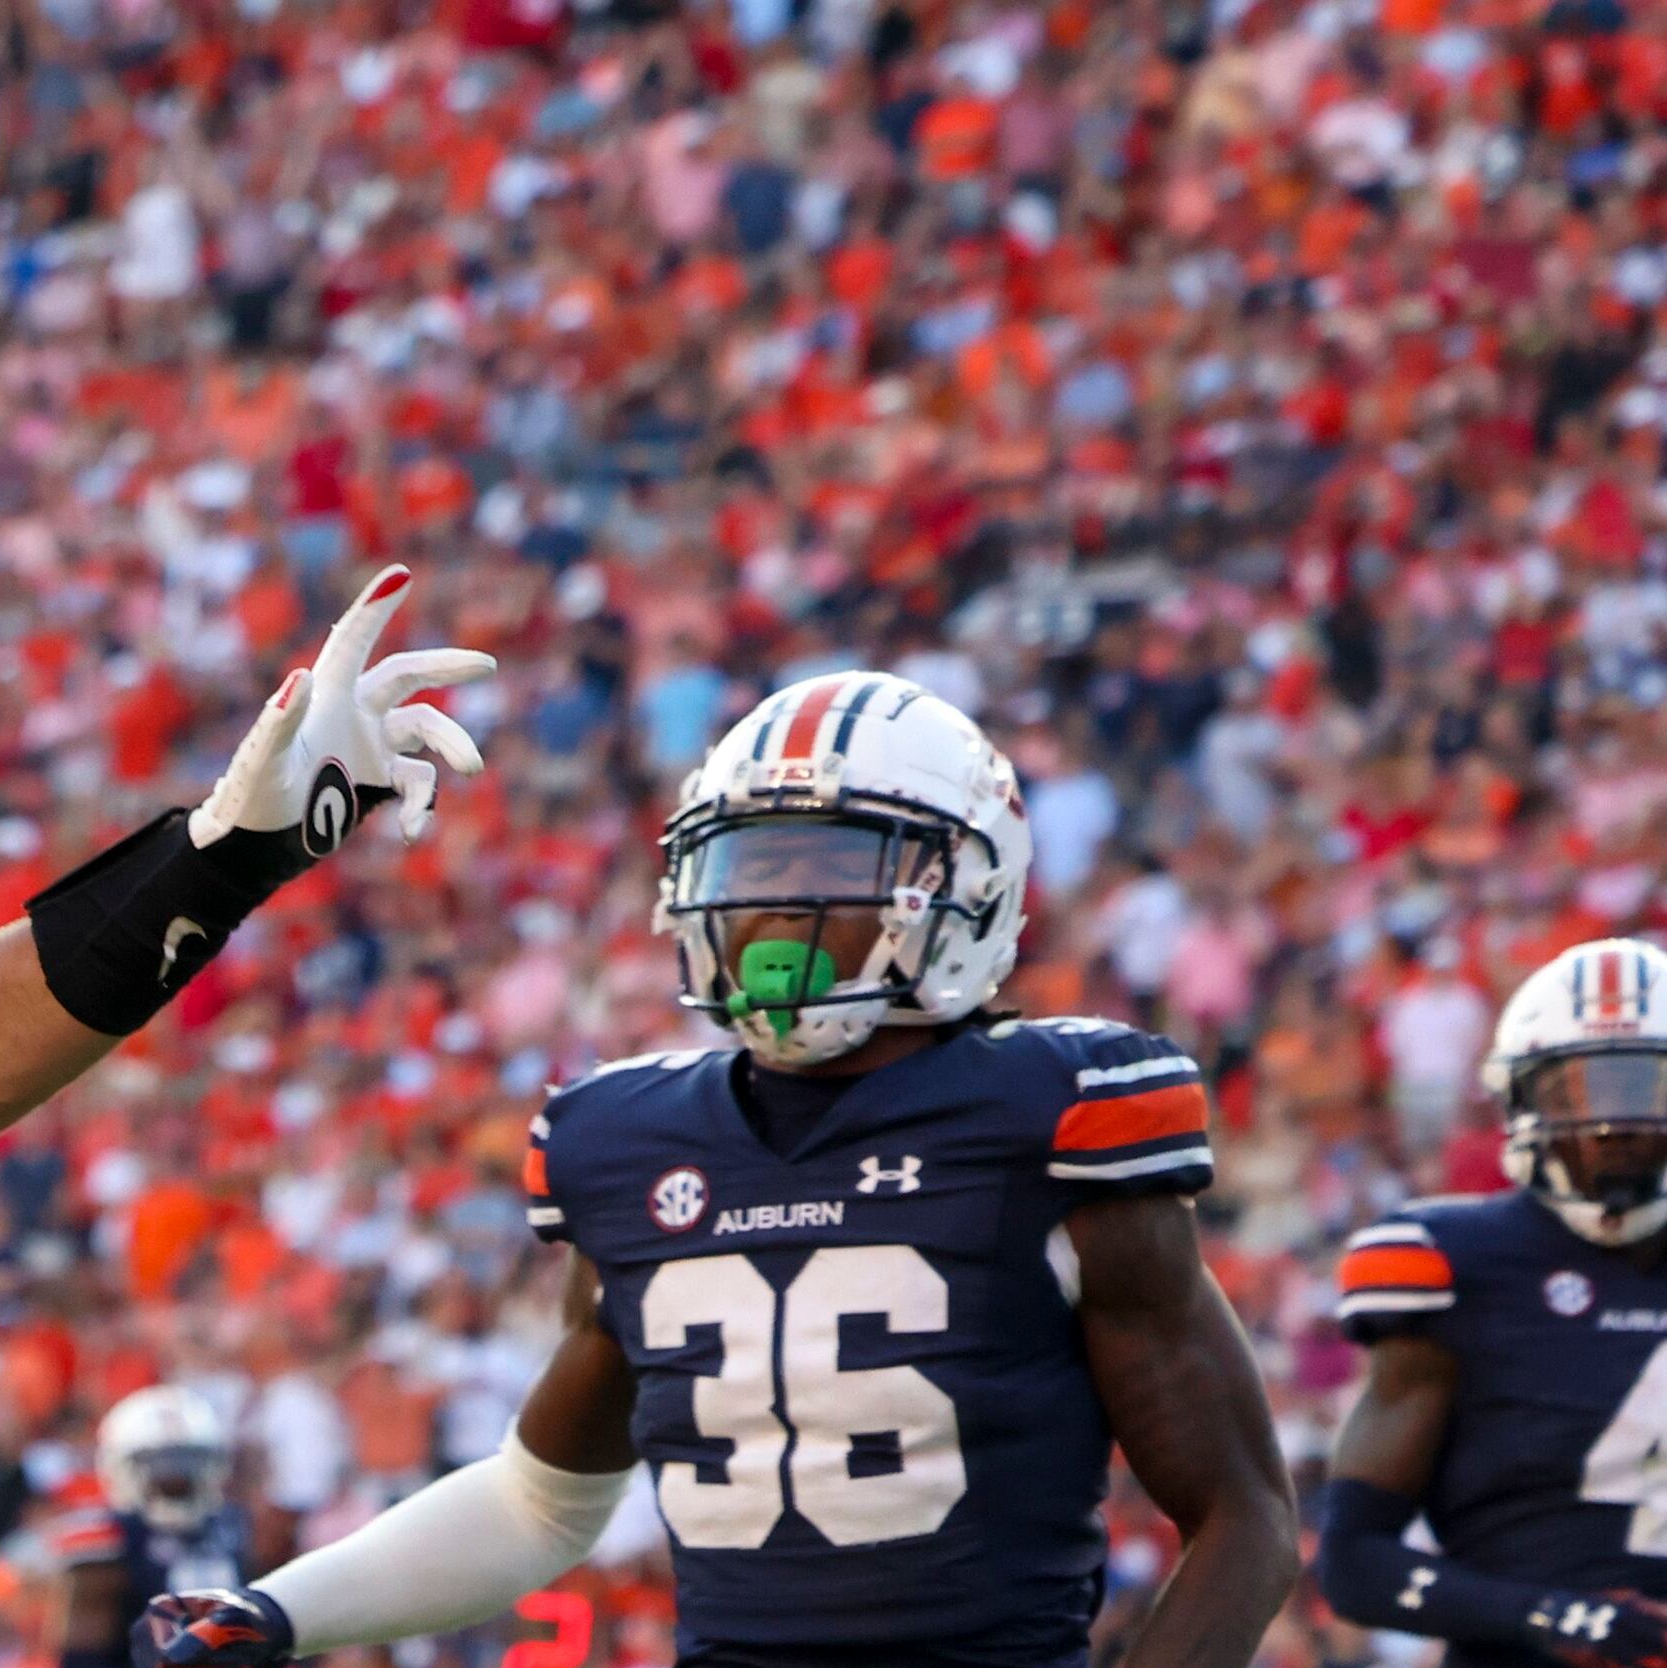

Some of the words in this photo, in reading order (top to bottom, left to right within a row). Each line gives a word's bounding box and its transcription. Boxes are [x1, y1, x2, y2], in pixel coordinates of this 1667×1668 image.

[651, 1168, 707, 1228] SEC
[713, 1200, 845, 1236] AUBURN
[640, 1244, 967, 1549] 36
